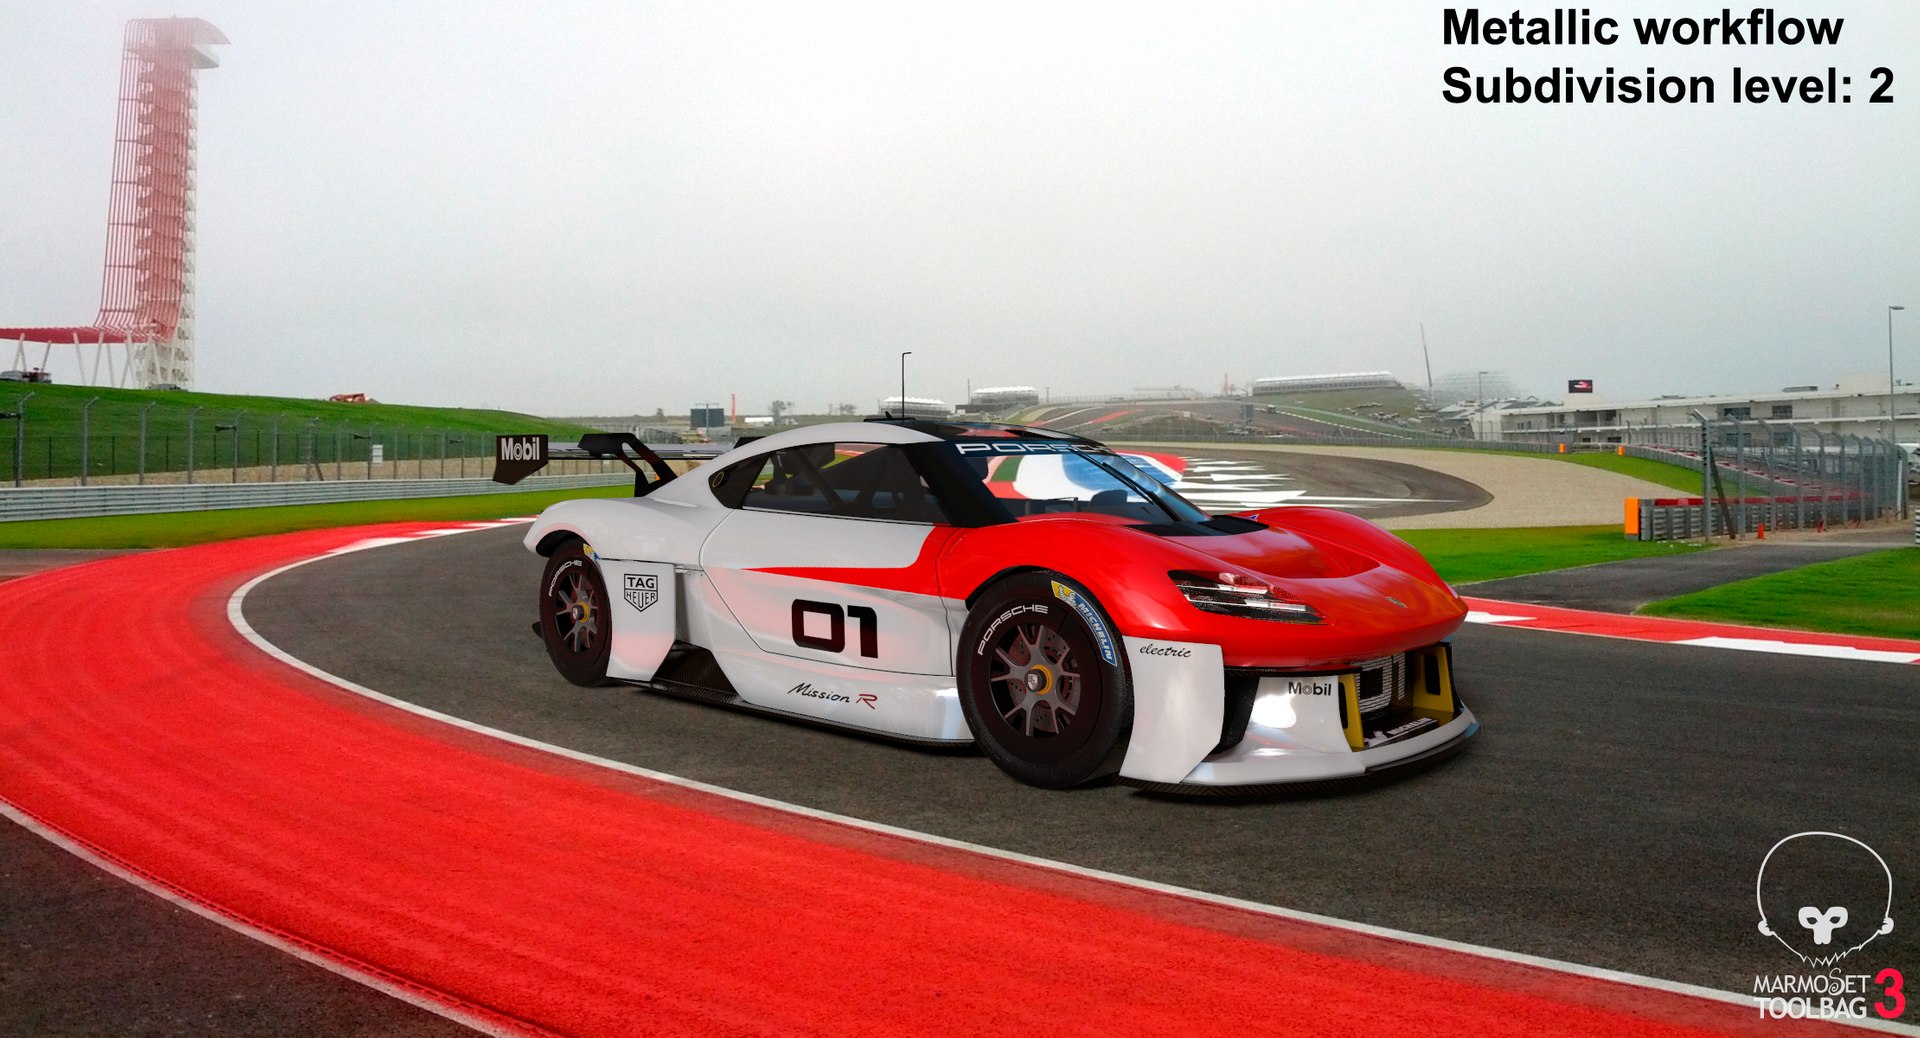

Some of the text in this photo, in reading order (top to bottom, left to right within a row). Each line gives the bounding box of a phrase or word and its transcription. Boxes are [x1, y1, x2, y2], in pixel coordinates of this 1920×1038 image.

[501, 437, 540, 461] Mobil
[627, 576, 655, 589] TAG
[626, 591, 656, 609] HEUER
[791, 598, 879, 659] 01
[977, 604, 1049, 656] PORSCHE
[1078, 603, 1113, 660] MICHELIN
[1140, 643, 1192, 658] electric
[787, 682, 878, 710] Mission R
[1288, 682, 1332, 697] Mobil
